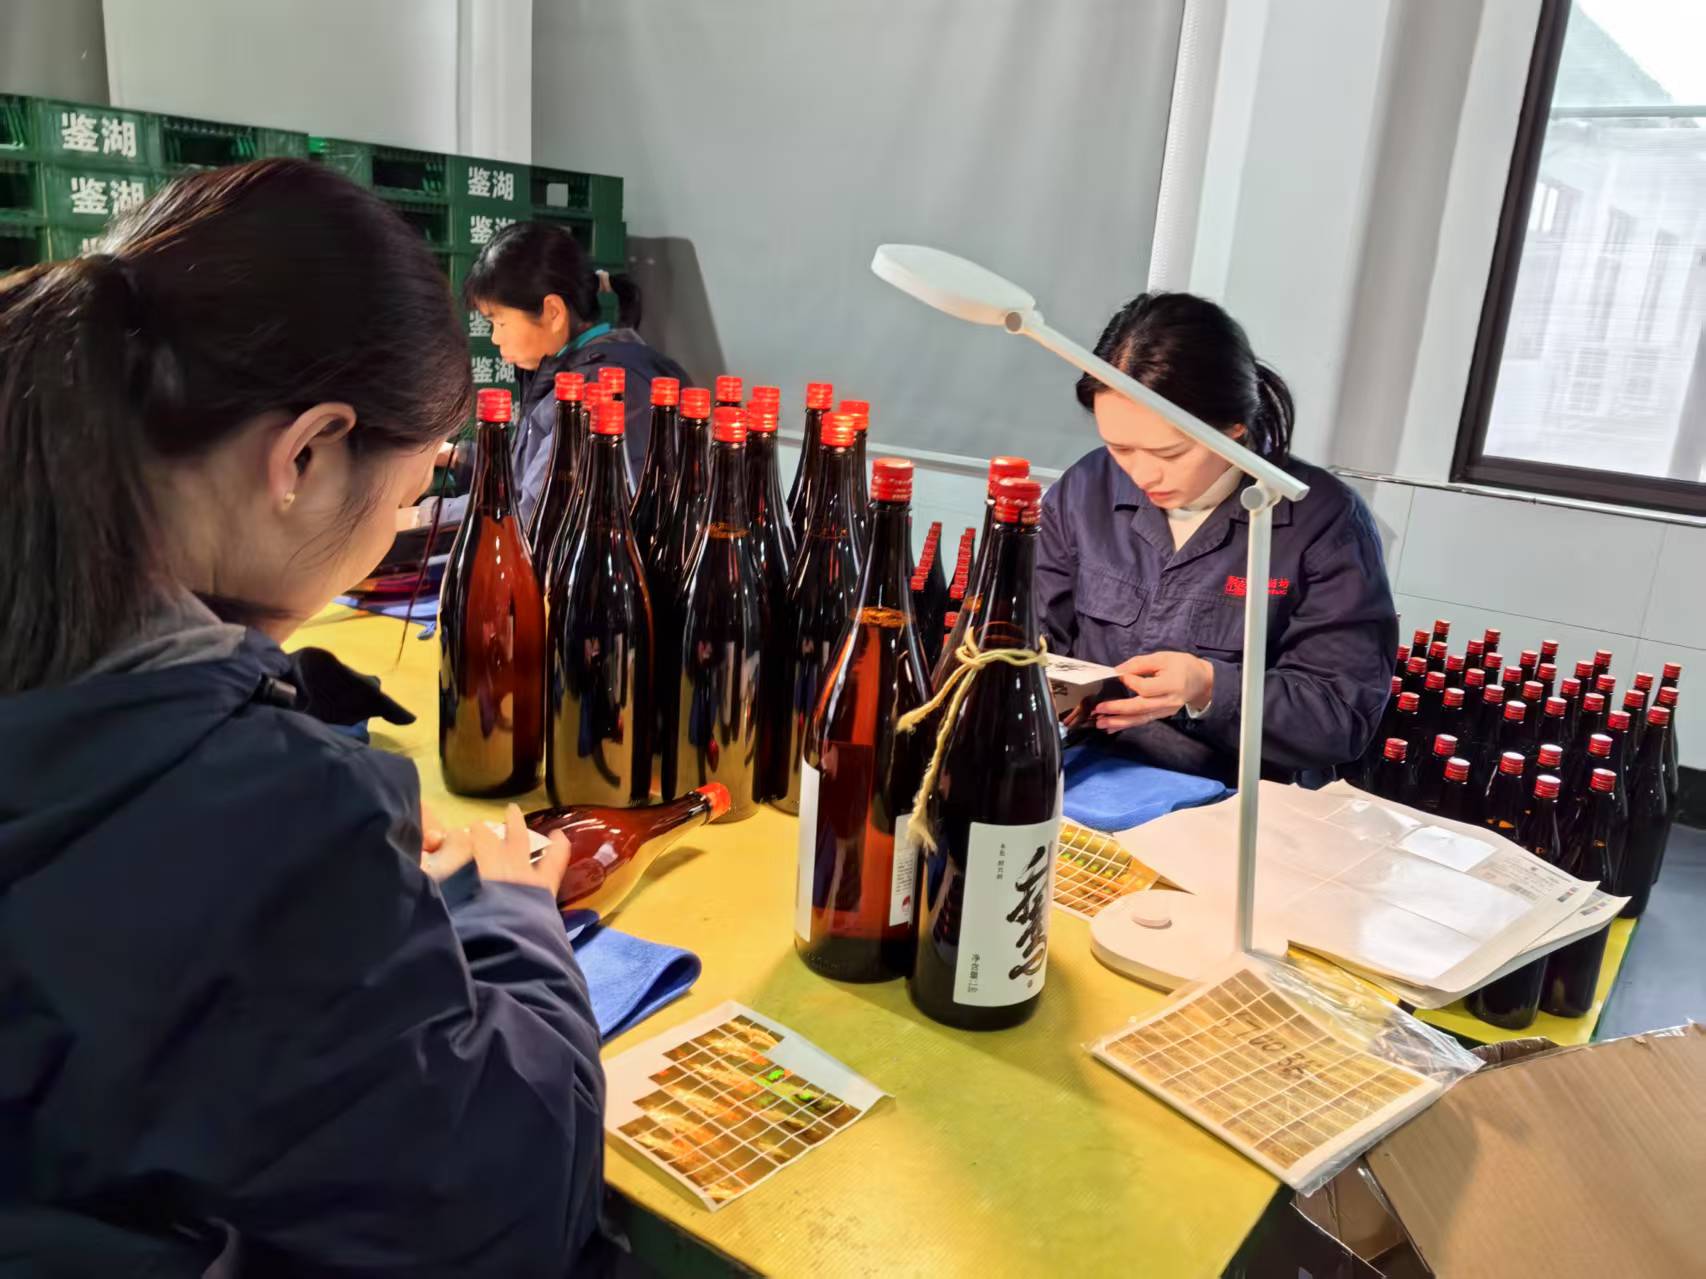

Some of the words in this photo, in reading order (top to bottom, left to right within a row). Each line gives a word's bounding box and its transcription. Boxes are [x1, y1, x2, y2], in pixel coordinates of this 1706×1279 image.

[61, 112, 137, 157] 鉴湖
[467, 166, 514, 201] 鉴湖
[472, 356, 515, 383] 鉴湖
